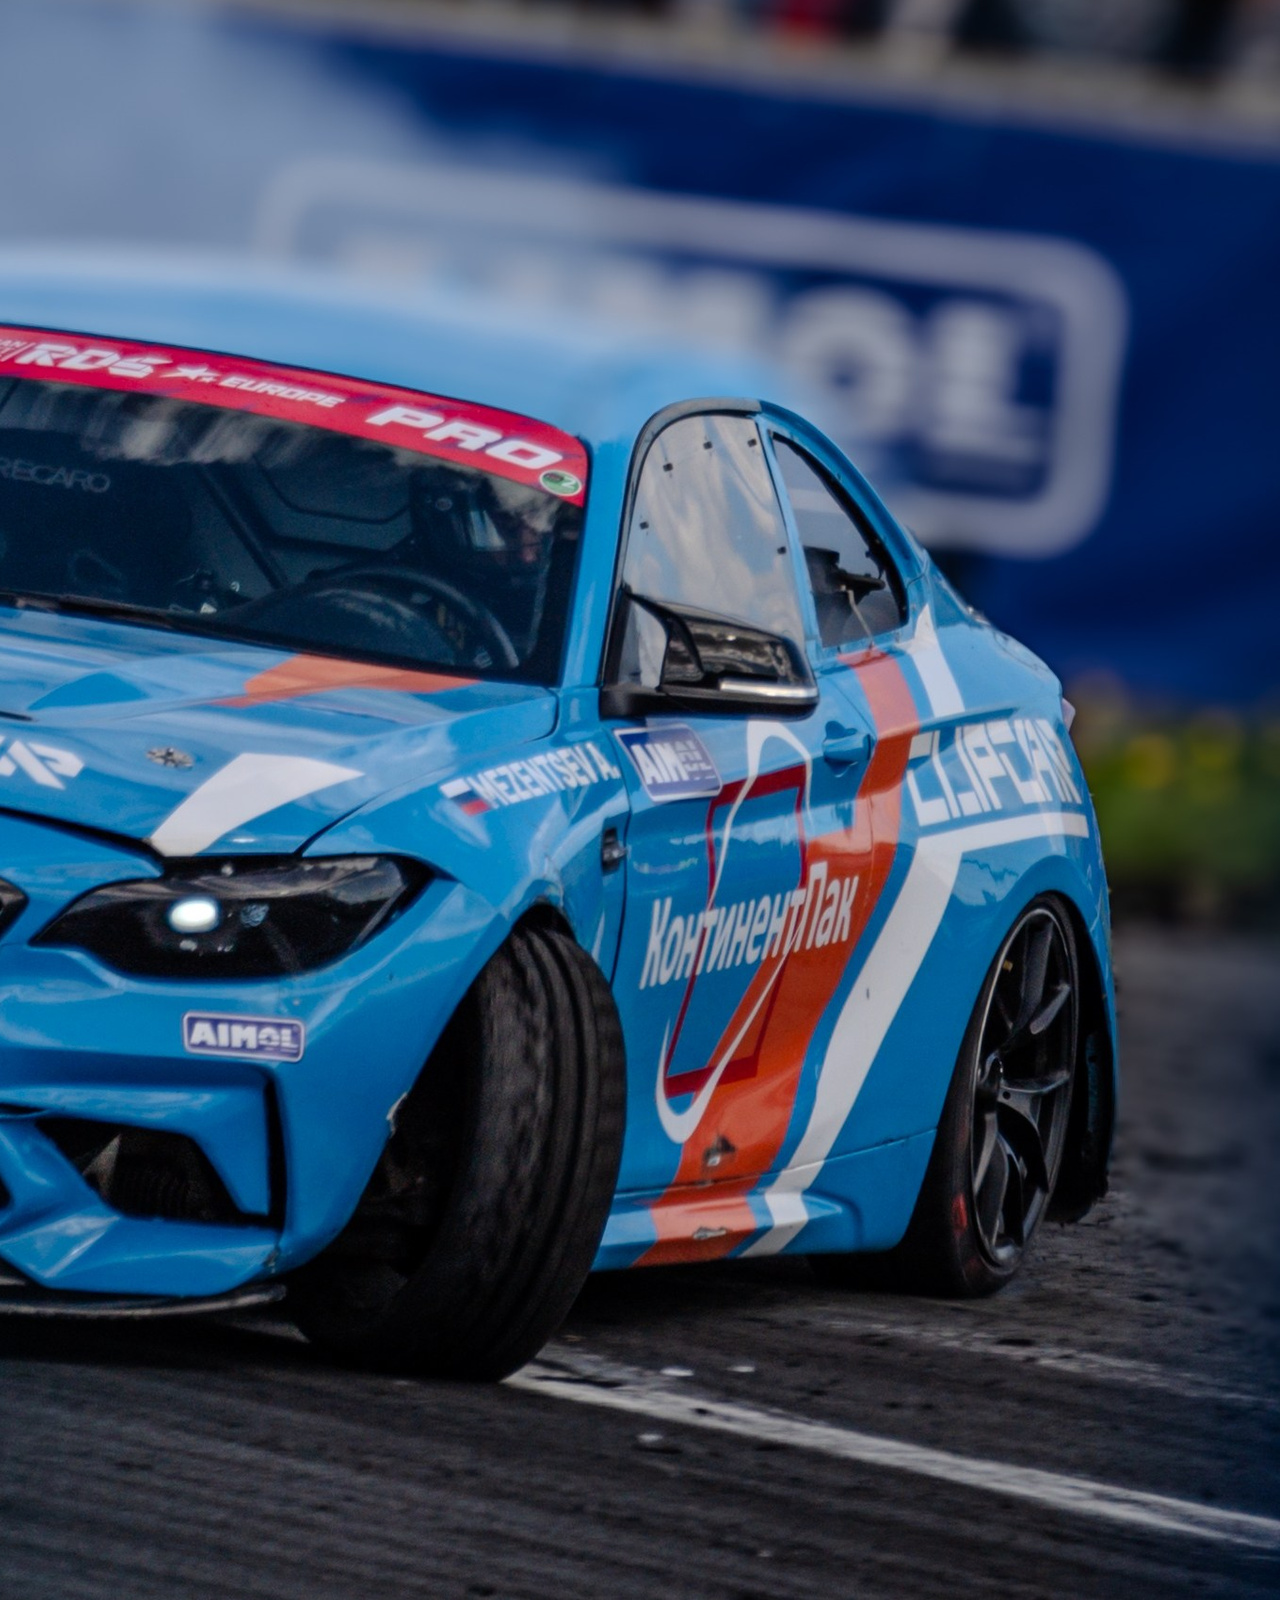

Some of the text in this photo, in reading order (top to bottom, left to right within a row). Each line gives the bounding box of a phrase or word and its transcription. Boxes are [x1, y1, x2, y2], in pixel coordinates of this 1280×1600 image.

[14, 343, 173, 378] RDS
[219, 376, 346, 408] EUROPE
[365, 406, 564, 470] PRO
[466, 742, 621, 810] MEZENTSEV A.
[906, 718, 1083, 827] CLIPCAR
[638, 860, 860, 991] КонтинентПак
[189, 1020, 299, 1051] AIMOL
